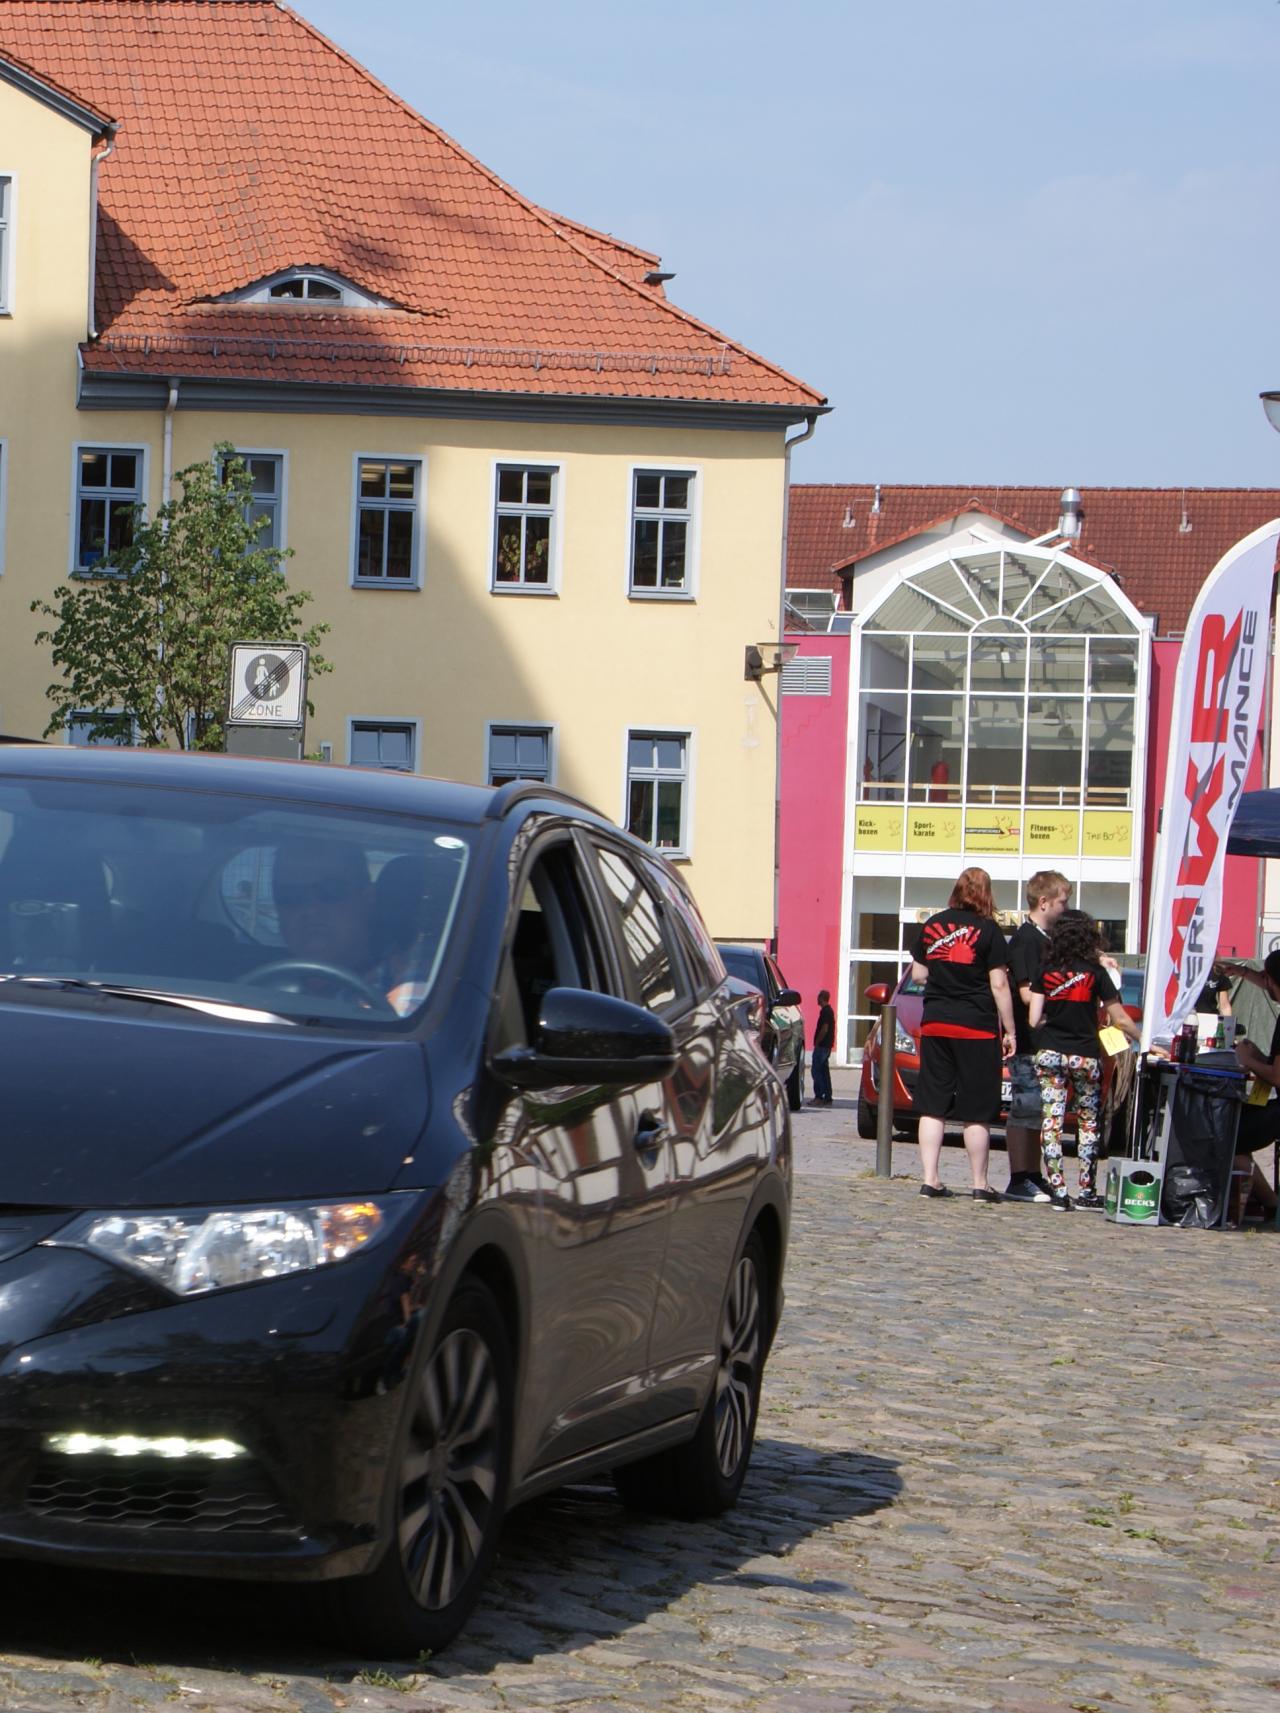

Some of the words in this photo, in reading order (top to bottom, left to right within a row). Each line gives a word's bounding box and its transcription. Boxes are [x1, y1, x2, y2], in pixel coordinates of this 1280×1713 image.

[248, 704, 282, 717] ZONE
[914, 821, 935, 829] Sport-
[1030, 824, 1058, 832] Fitness-
[913, 829, 935, 837] karate
